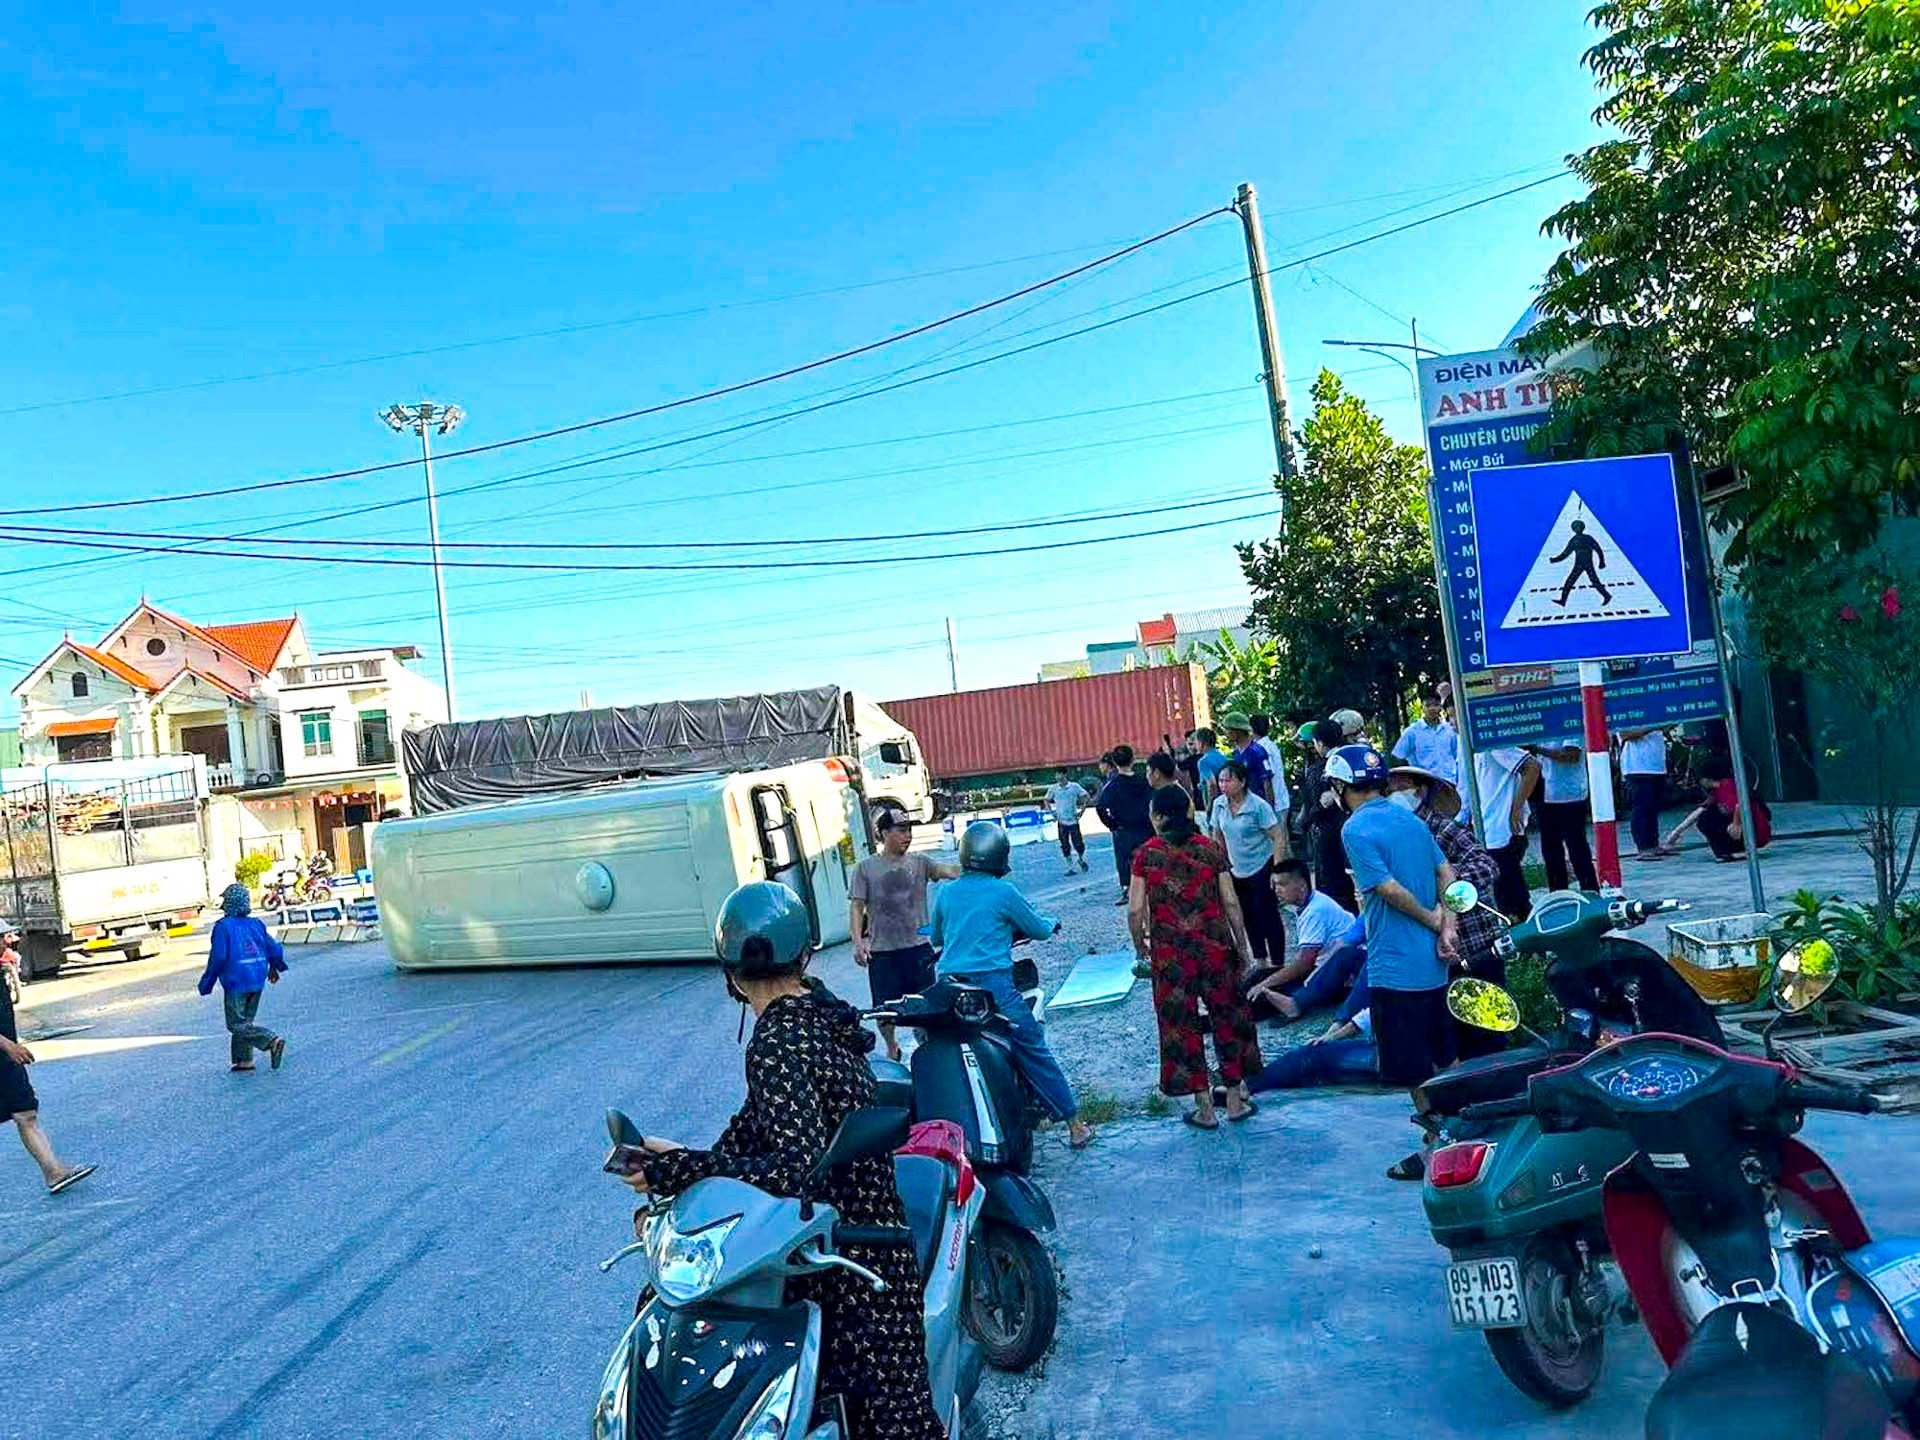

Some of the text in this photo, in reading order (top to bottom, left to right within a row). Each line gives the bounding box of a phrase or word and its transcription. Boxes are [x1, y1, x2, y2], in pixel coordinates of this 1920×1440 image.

[1436, 362, 1492, 383] ĐIỆN
[1436, 387, 1508, 418] ANH
[1440, 427, 1497, 450] CHUYÊN
[1483, 453, 1504, 467] Bút
[1498, 671, 1549, 687] STIHL
[1452, 1293, 1521, 1325] 151.23
